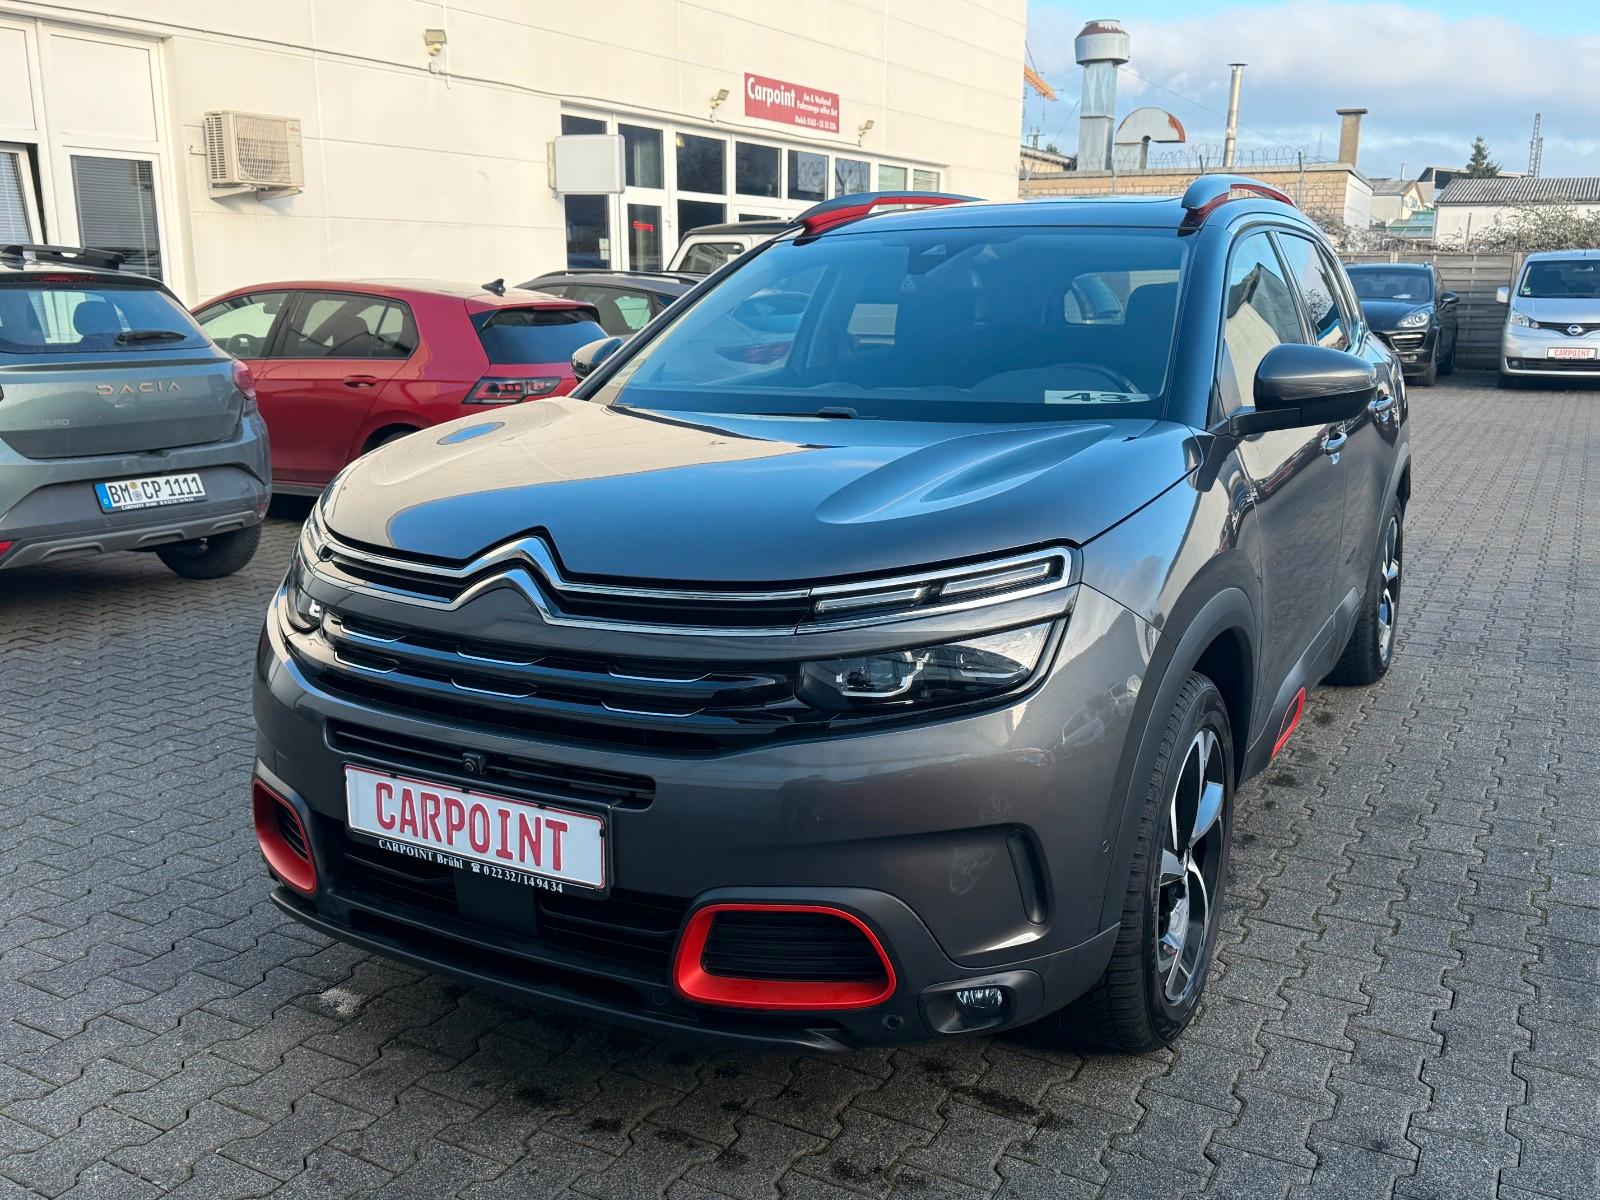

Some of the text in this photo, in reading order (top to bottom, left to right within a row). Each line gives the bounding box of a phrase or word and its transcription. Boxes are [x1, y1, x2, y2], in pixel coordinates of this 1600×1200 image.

[748, 77, 796, 107] Carpoint
[1555, 349, 1590, 357] CARPOINT
[96, 381, 182, 396] DACIA
[1062, 392, 1132, 403] 43
[108, 476, 203, 504] BM CP 1111
[376, 782, 568, 871] CARPOINT
[378, 839, 434, 862] CARPOINT
[436, 853, 464, 870] Brühl
